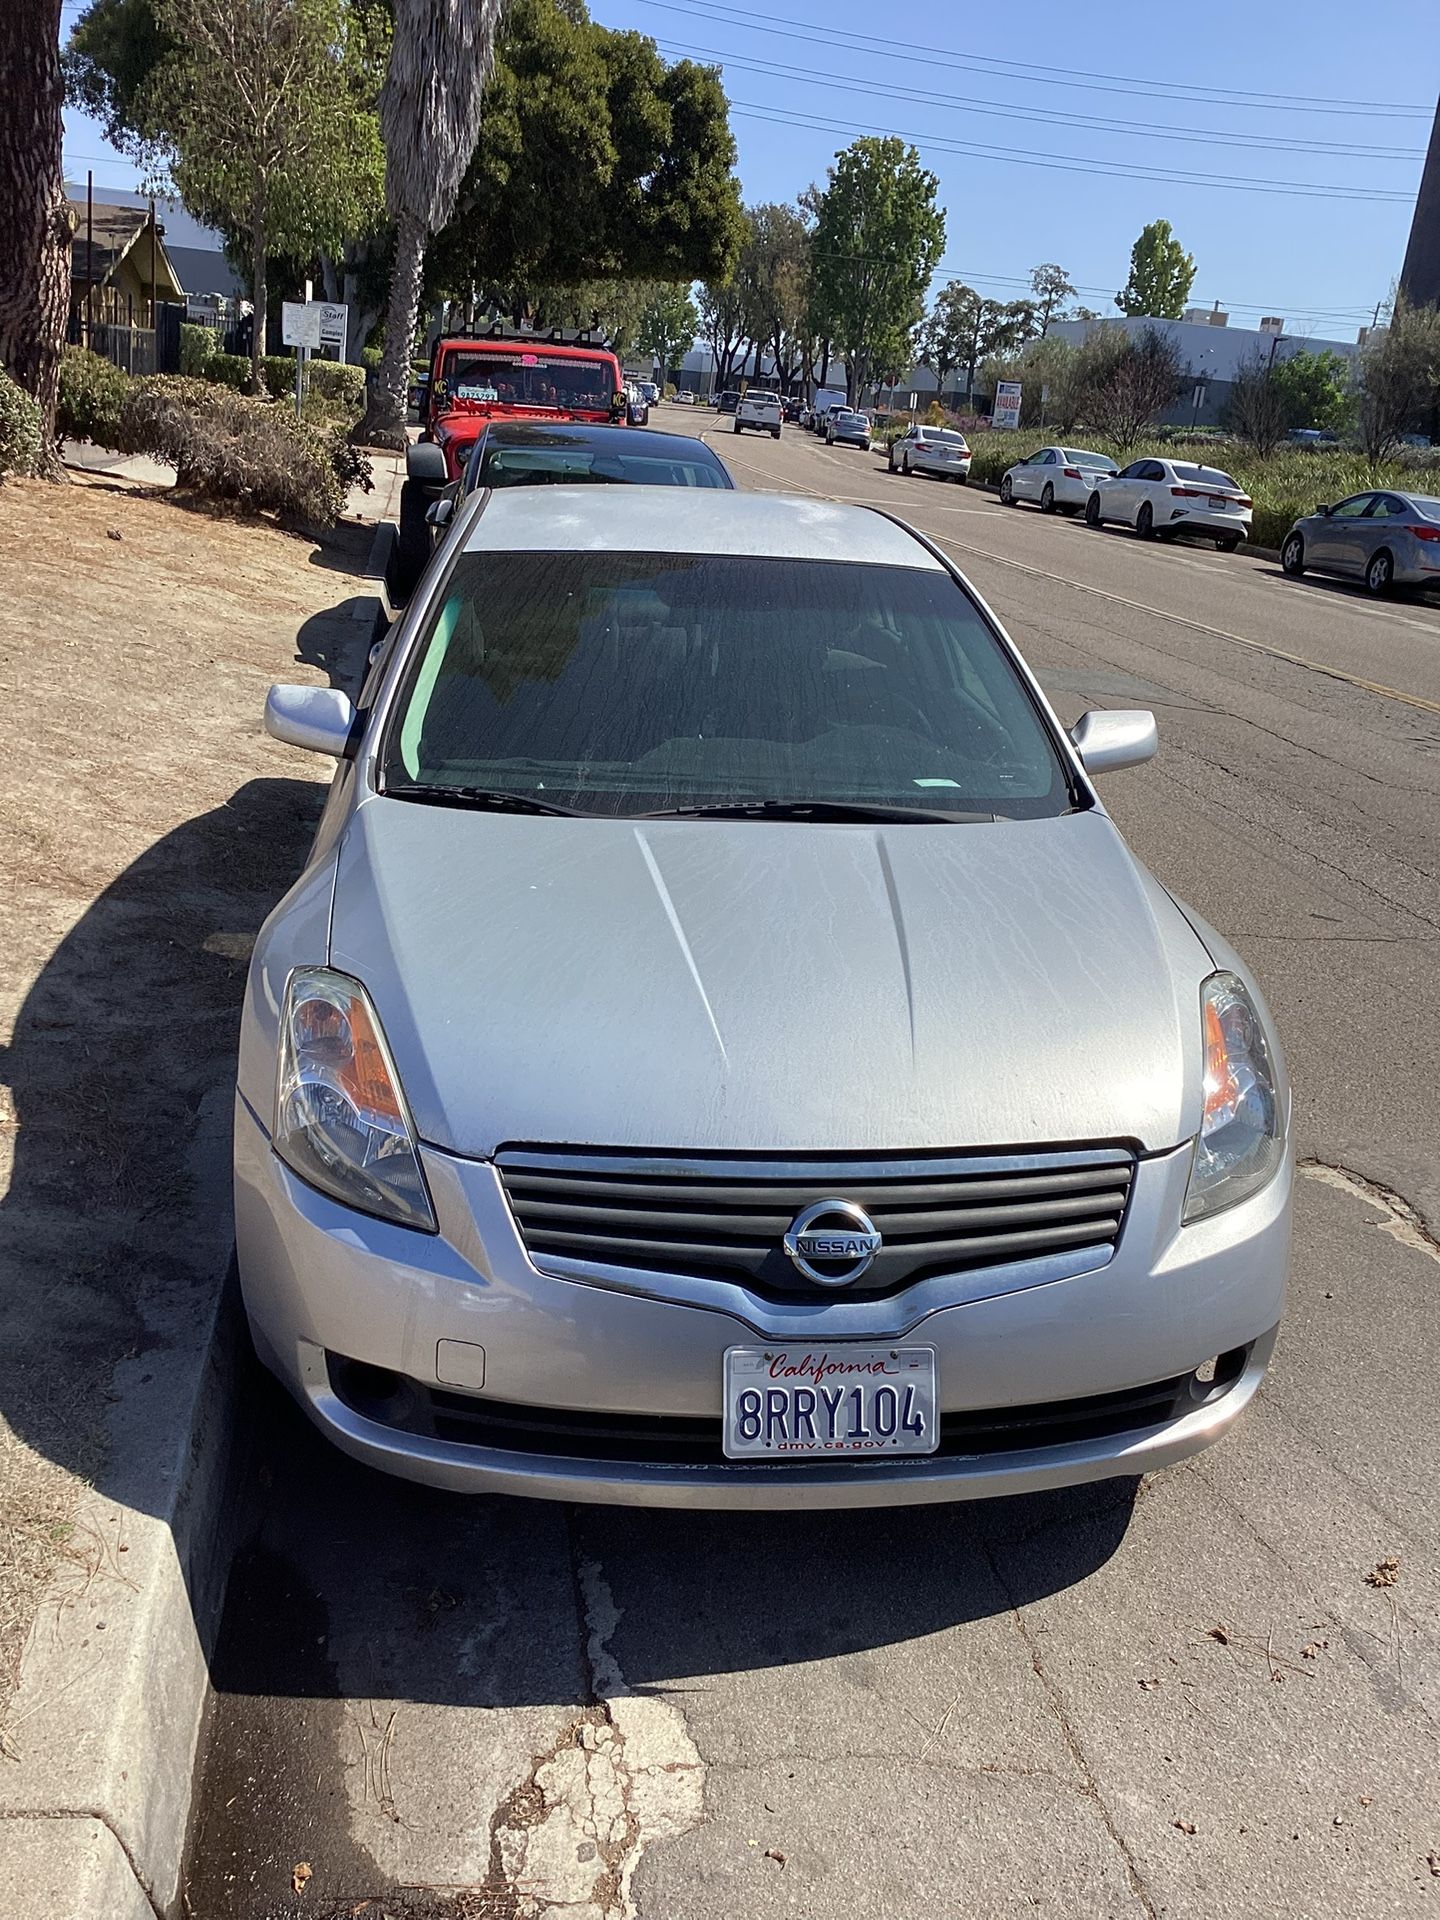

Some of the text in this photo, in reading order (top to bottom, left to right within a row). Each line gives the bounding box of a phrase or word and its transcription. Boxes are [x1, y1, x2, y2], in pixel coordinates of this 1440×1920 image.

[434, 380, 447, 394] KC
[613, 393, 625, 406] KC
[796, 1238, 873, 1253] NISSAN
[769, 1353, 899, 1385] California
[738, 1385, 926, 1440] 8RRY104
[777, 1439, 886, 1451] dmv.ca.gov
